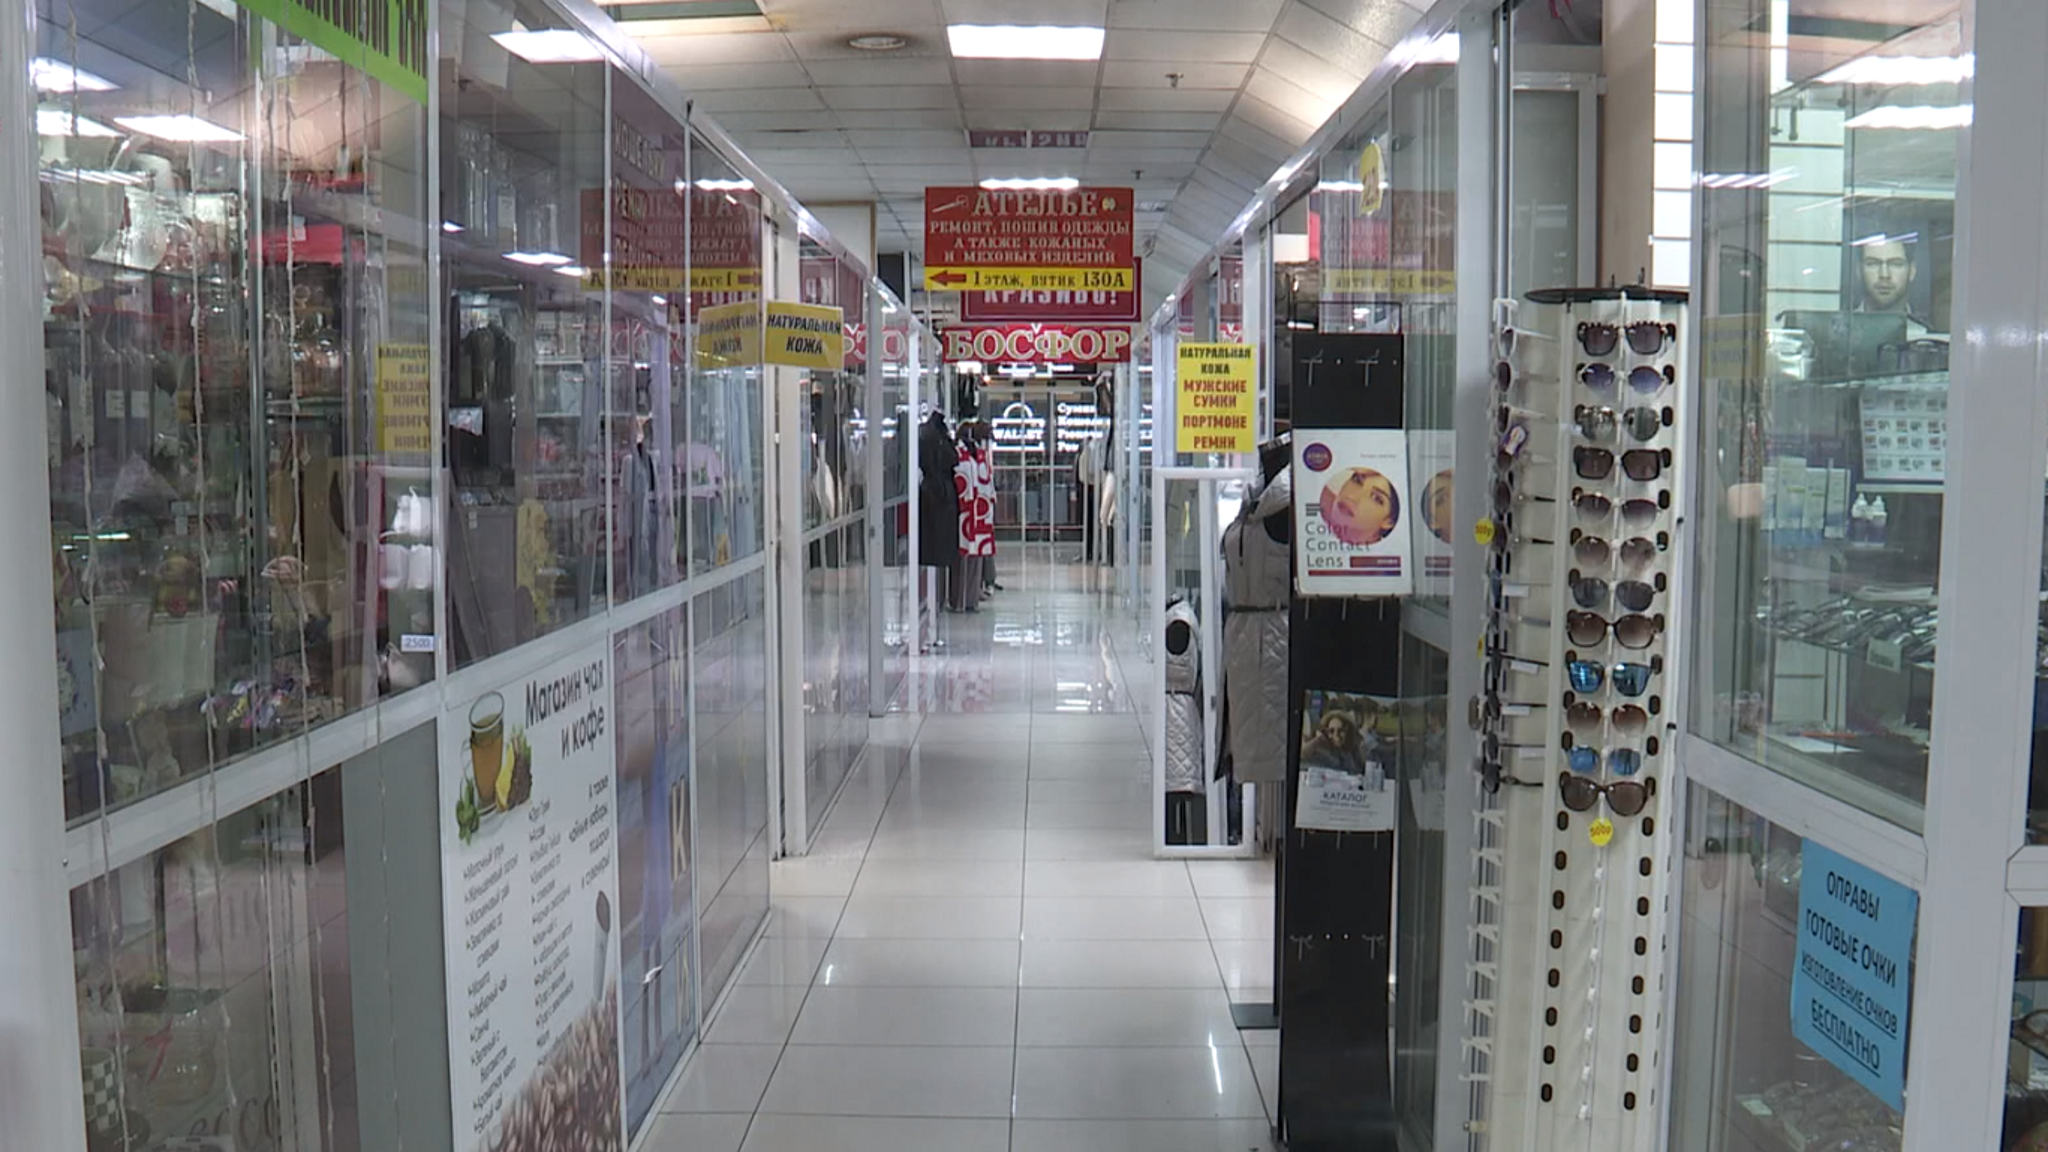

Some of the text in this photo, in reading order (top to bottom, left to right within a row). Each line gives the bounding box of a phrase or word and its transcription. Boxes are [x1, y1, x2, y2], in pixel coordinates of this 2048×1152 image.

[972, 191, 1097, 217] АТЕЛЬЕ
[930, 220, 1130, 236] РЕМОНТ, ПОШИВ ОДЕЖДЫ
[953, 237, 1107, 249] А ТАКЖЕ КОЖАНЫХ
[944, 249, 1116, 265] И МЕХОВЫХ ИЗДЕЛИЙ
[974, 271, 1126, 288] 1 ЭТАЖ, БУТИК 130А
[767, 313, 841, 335] НАТУРАЛЬНАЯ
[785, 336, 823, 355] КОЖА
[946, 330, 1129, 360] БОСФОР
[1180, 346, 1251, 359] НАТУРАЛЬНАЯ
[1201, 363, 1230, 375] КОЖА
[1183, 380, 1247, 393] МУЖСКИЕ
[1193, 394, 1237, 408] СУМКИ
[1183, 415, 1247, 429] ПОРТМОНЕ
[1193, 436, 1236, 449] РЕМНИ
[1305, 521, 1348, 535] Color
[1305, 537, 1371, 552] Contact
[1307, 554, 1344, 568] Lens
[525, 663, 605, 729] Магазин чая
[562, 704, 605, 760] и кофе
[1323, 791, 1368, 803] КАТАЛОГ
[1826, 871, 1880, 922] ОПРАВЫ
[1806, 908, 1897, 988] ГОТОВЫЕ ОЧКИ
[1802, 951, 1898, 1034] ИЗГОТОВЛЕНИЕ ОЧКОВ
[1812, 998, 1881, 1070] БЕСПЛАТНО
